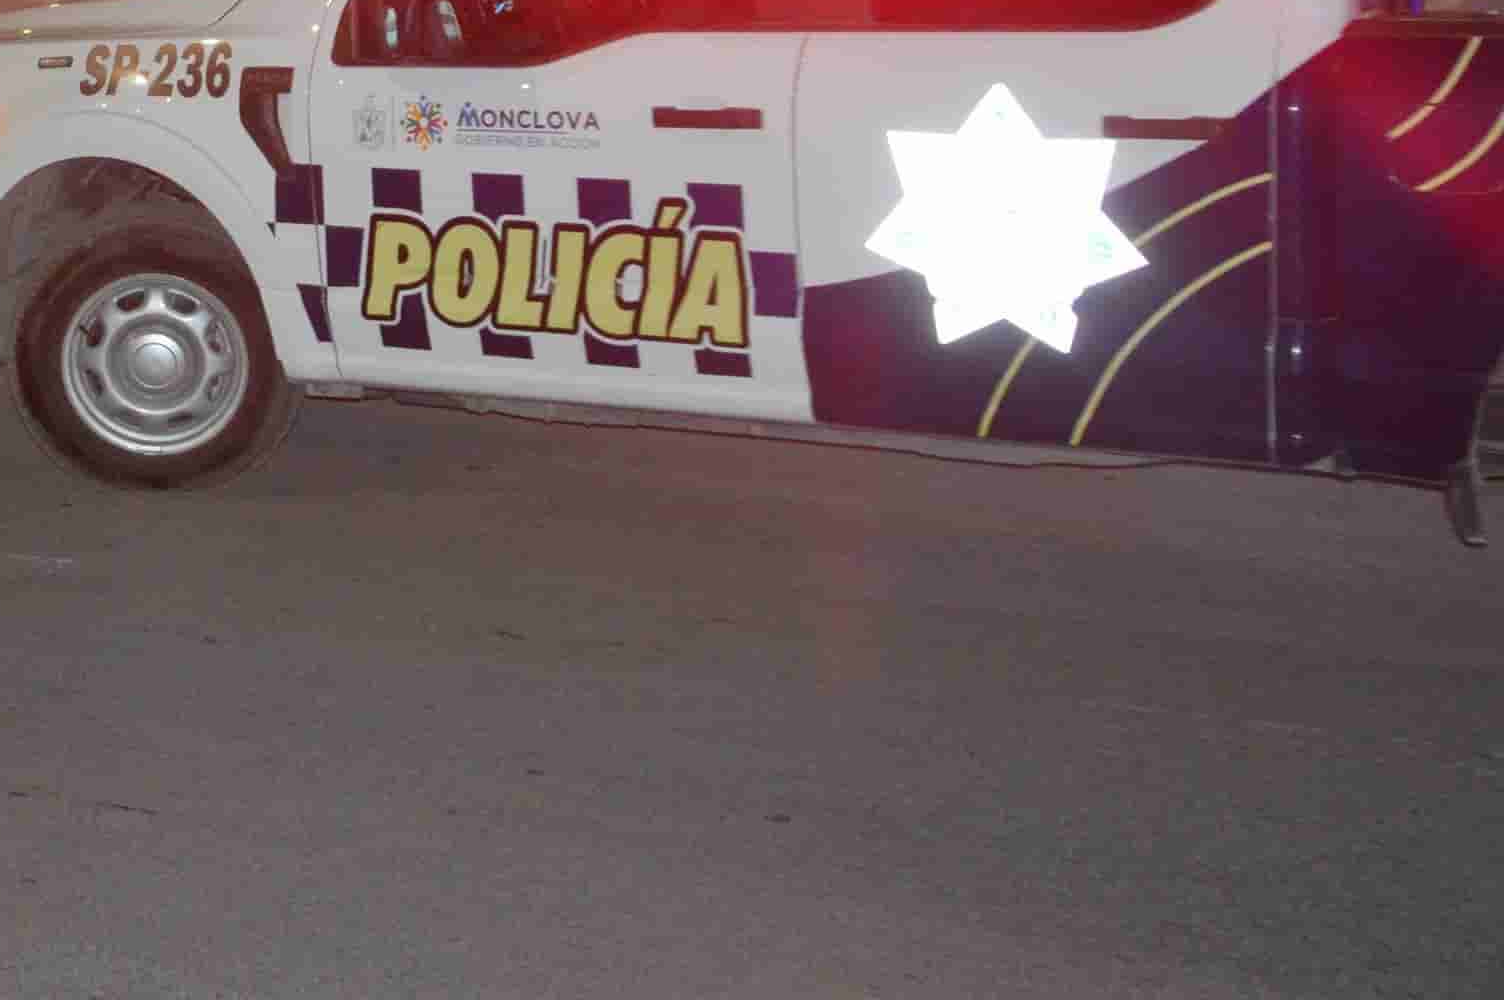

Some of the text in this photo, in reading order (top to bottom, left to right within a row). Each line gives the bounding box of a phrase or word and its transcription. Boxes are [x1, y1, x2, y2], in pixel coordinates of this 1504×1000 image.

[80, 42, 232, 98] SP-236
[456, 101, 600, 130] MONCLOVA
[362, 197, 749, 348] POLICÍA
